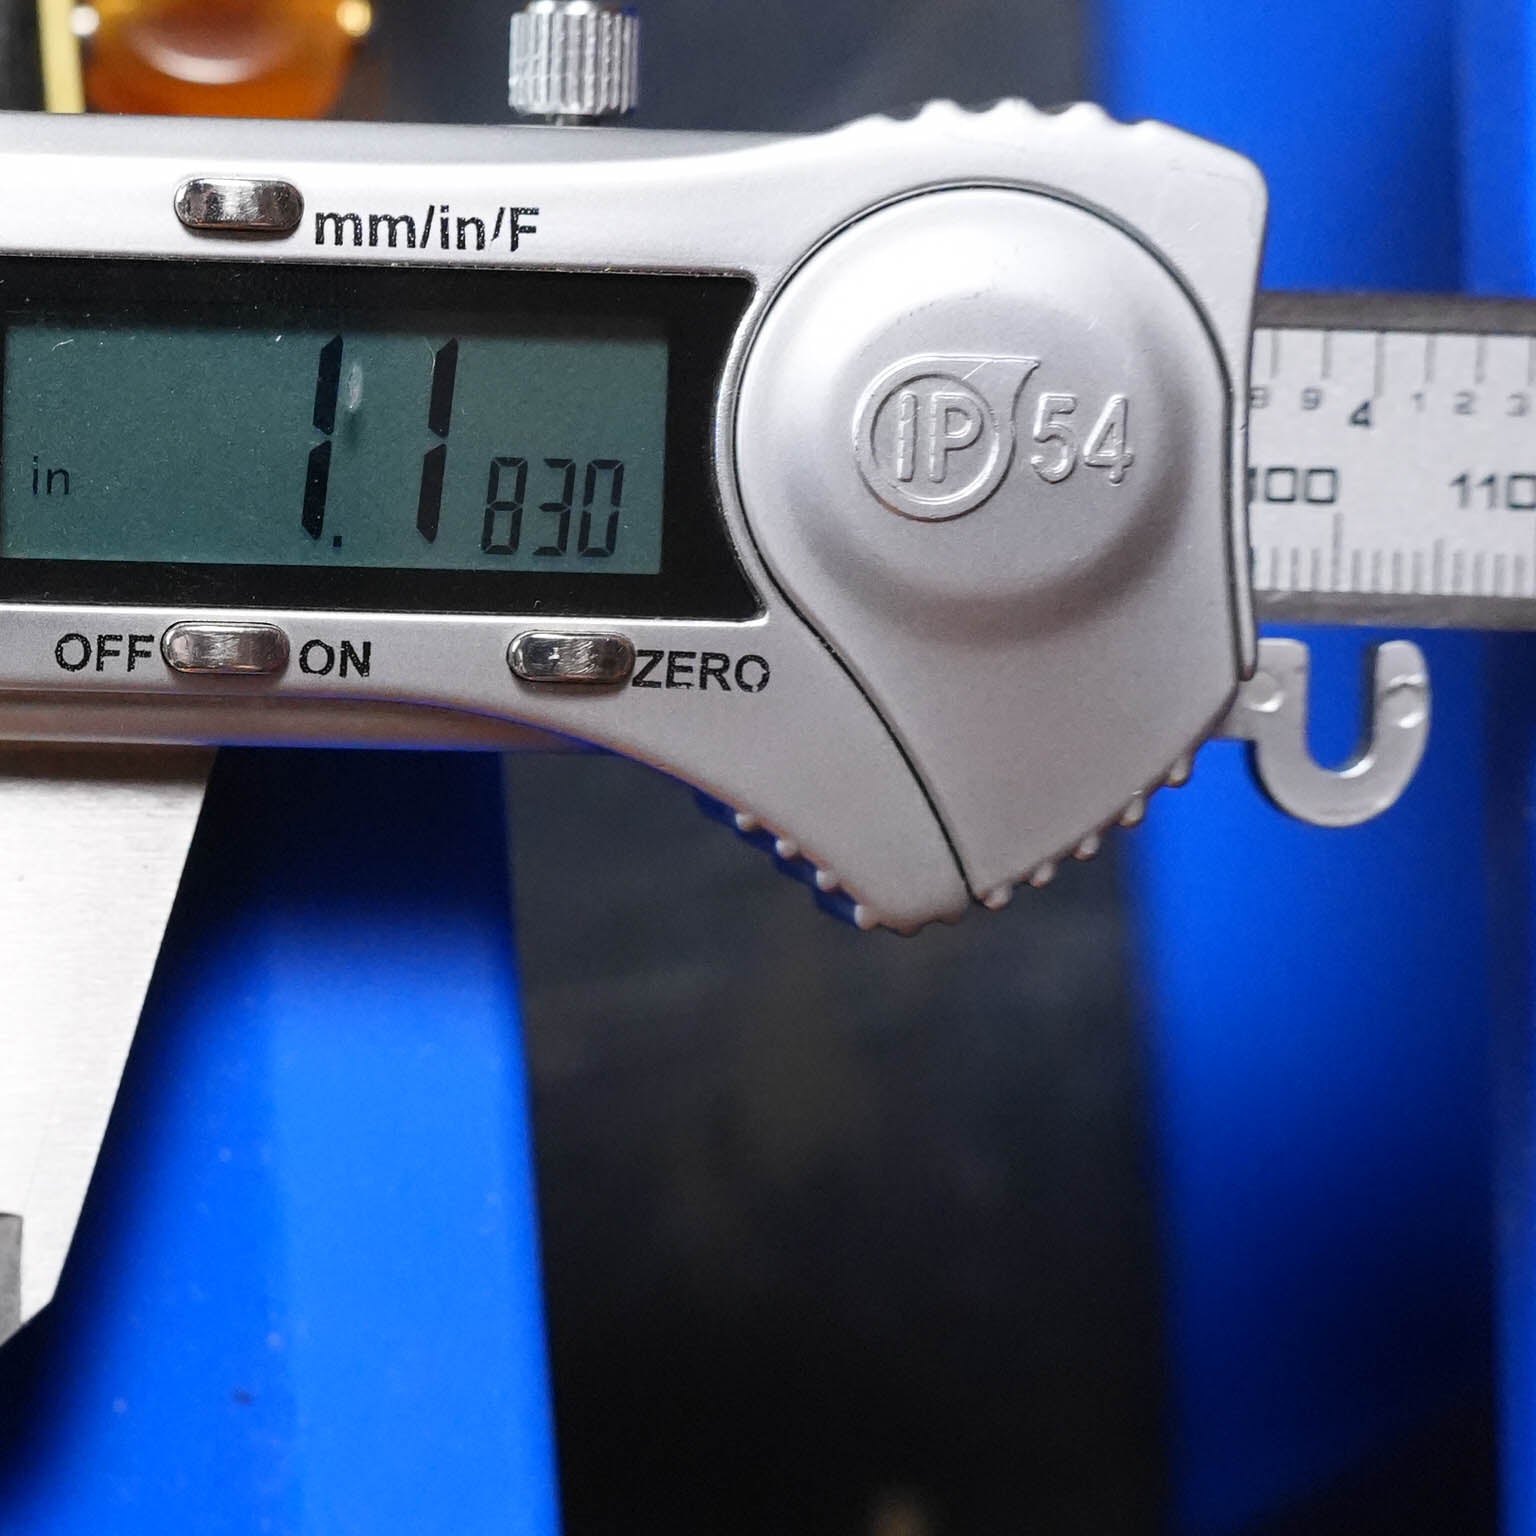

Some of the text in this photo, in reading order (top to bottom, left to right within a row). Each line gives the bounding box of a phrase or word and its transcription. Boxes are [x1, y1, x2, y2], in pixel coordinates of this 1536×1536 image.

[314, 204, 540, 253] mm/in/F
[1302, 387, 1322, 411] 9
[1349, 400, 1372, 428] 4
[1410, 392, 1427, 412] 1
[1454, 391, 1475, 416] 2
[1506, 391, 1528, 418] 3
[895, 392, 1135, 486] IP 54
[32, 455, 70, 497] in
[54, 632, 771, 693] OFF ON ZERO
